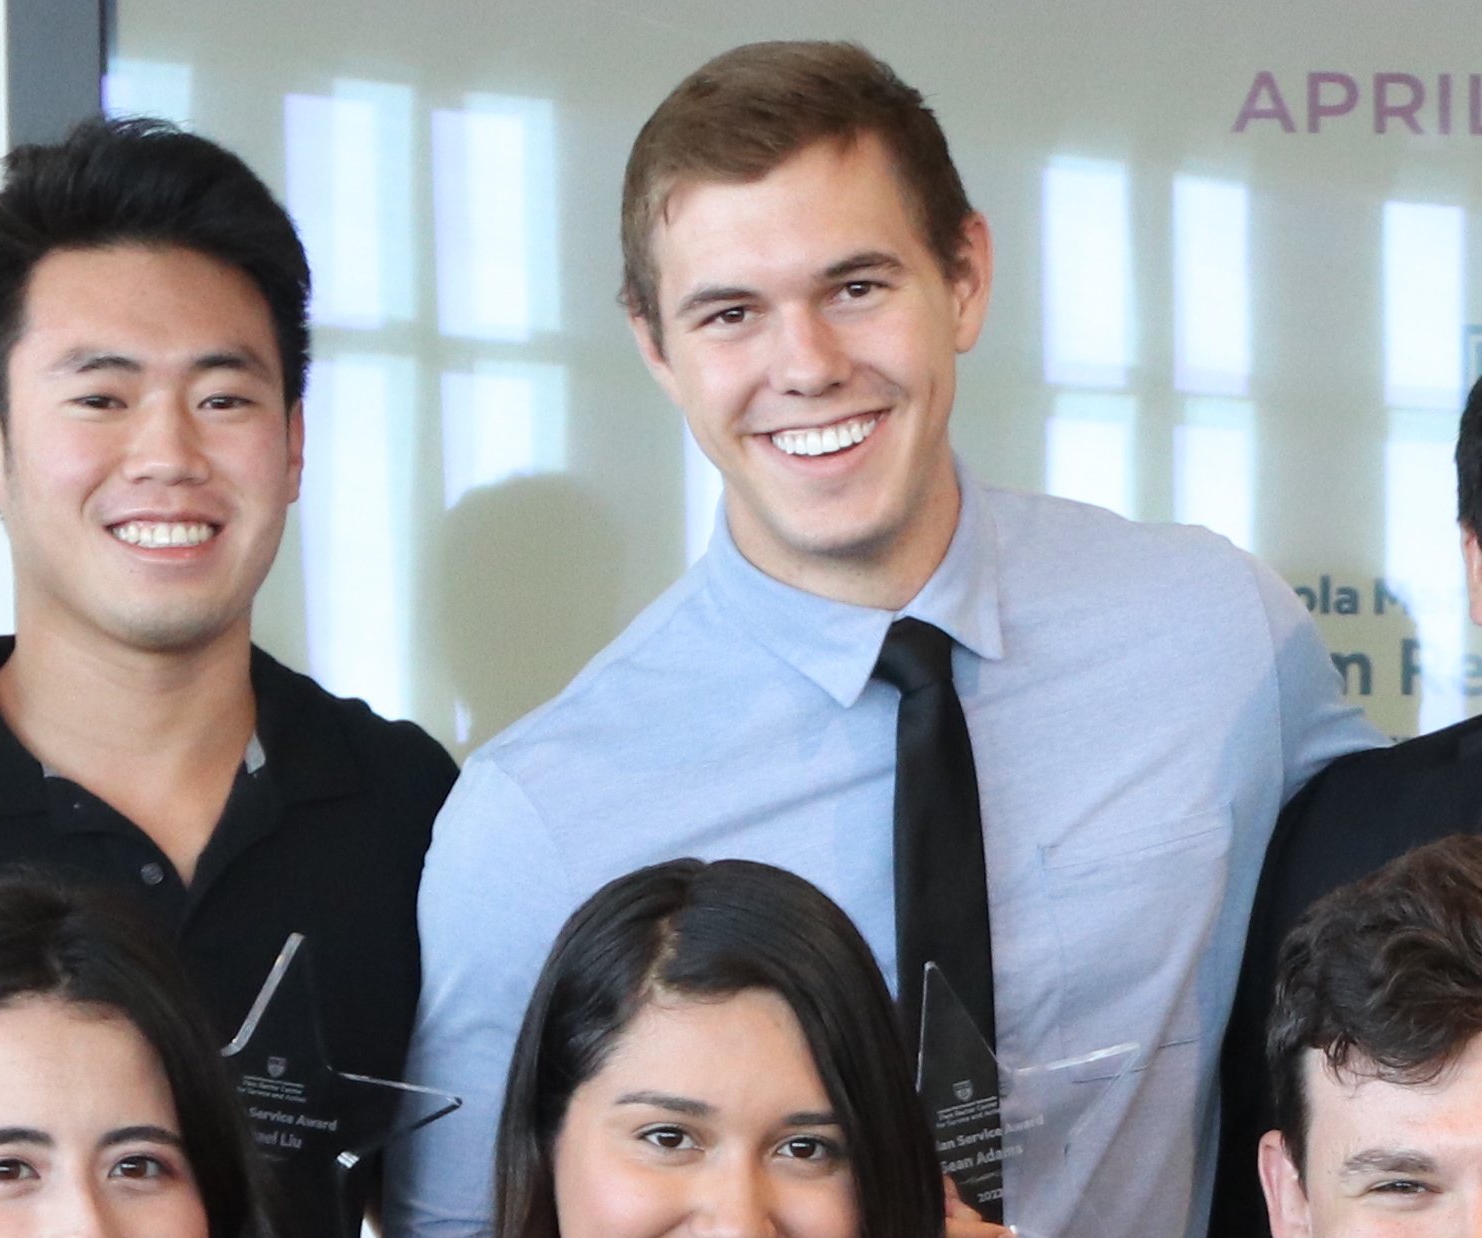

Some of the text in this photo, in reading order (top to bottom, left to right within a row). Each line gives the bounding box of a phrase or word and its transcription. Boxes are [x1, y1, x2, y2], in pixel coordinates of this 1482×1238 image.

[249, 1107, 337, 1131] Service Award
[280, 1133, 302, 1149] Liu
[957, 1128, 1003, 1147] Service
